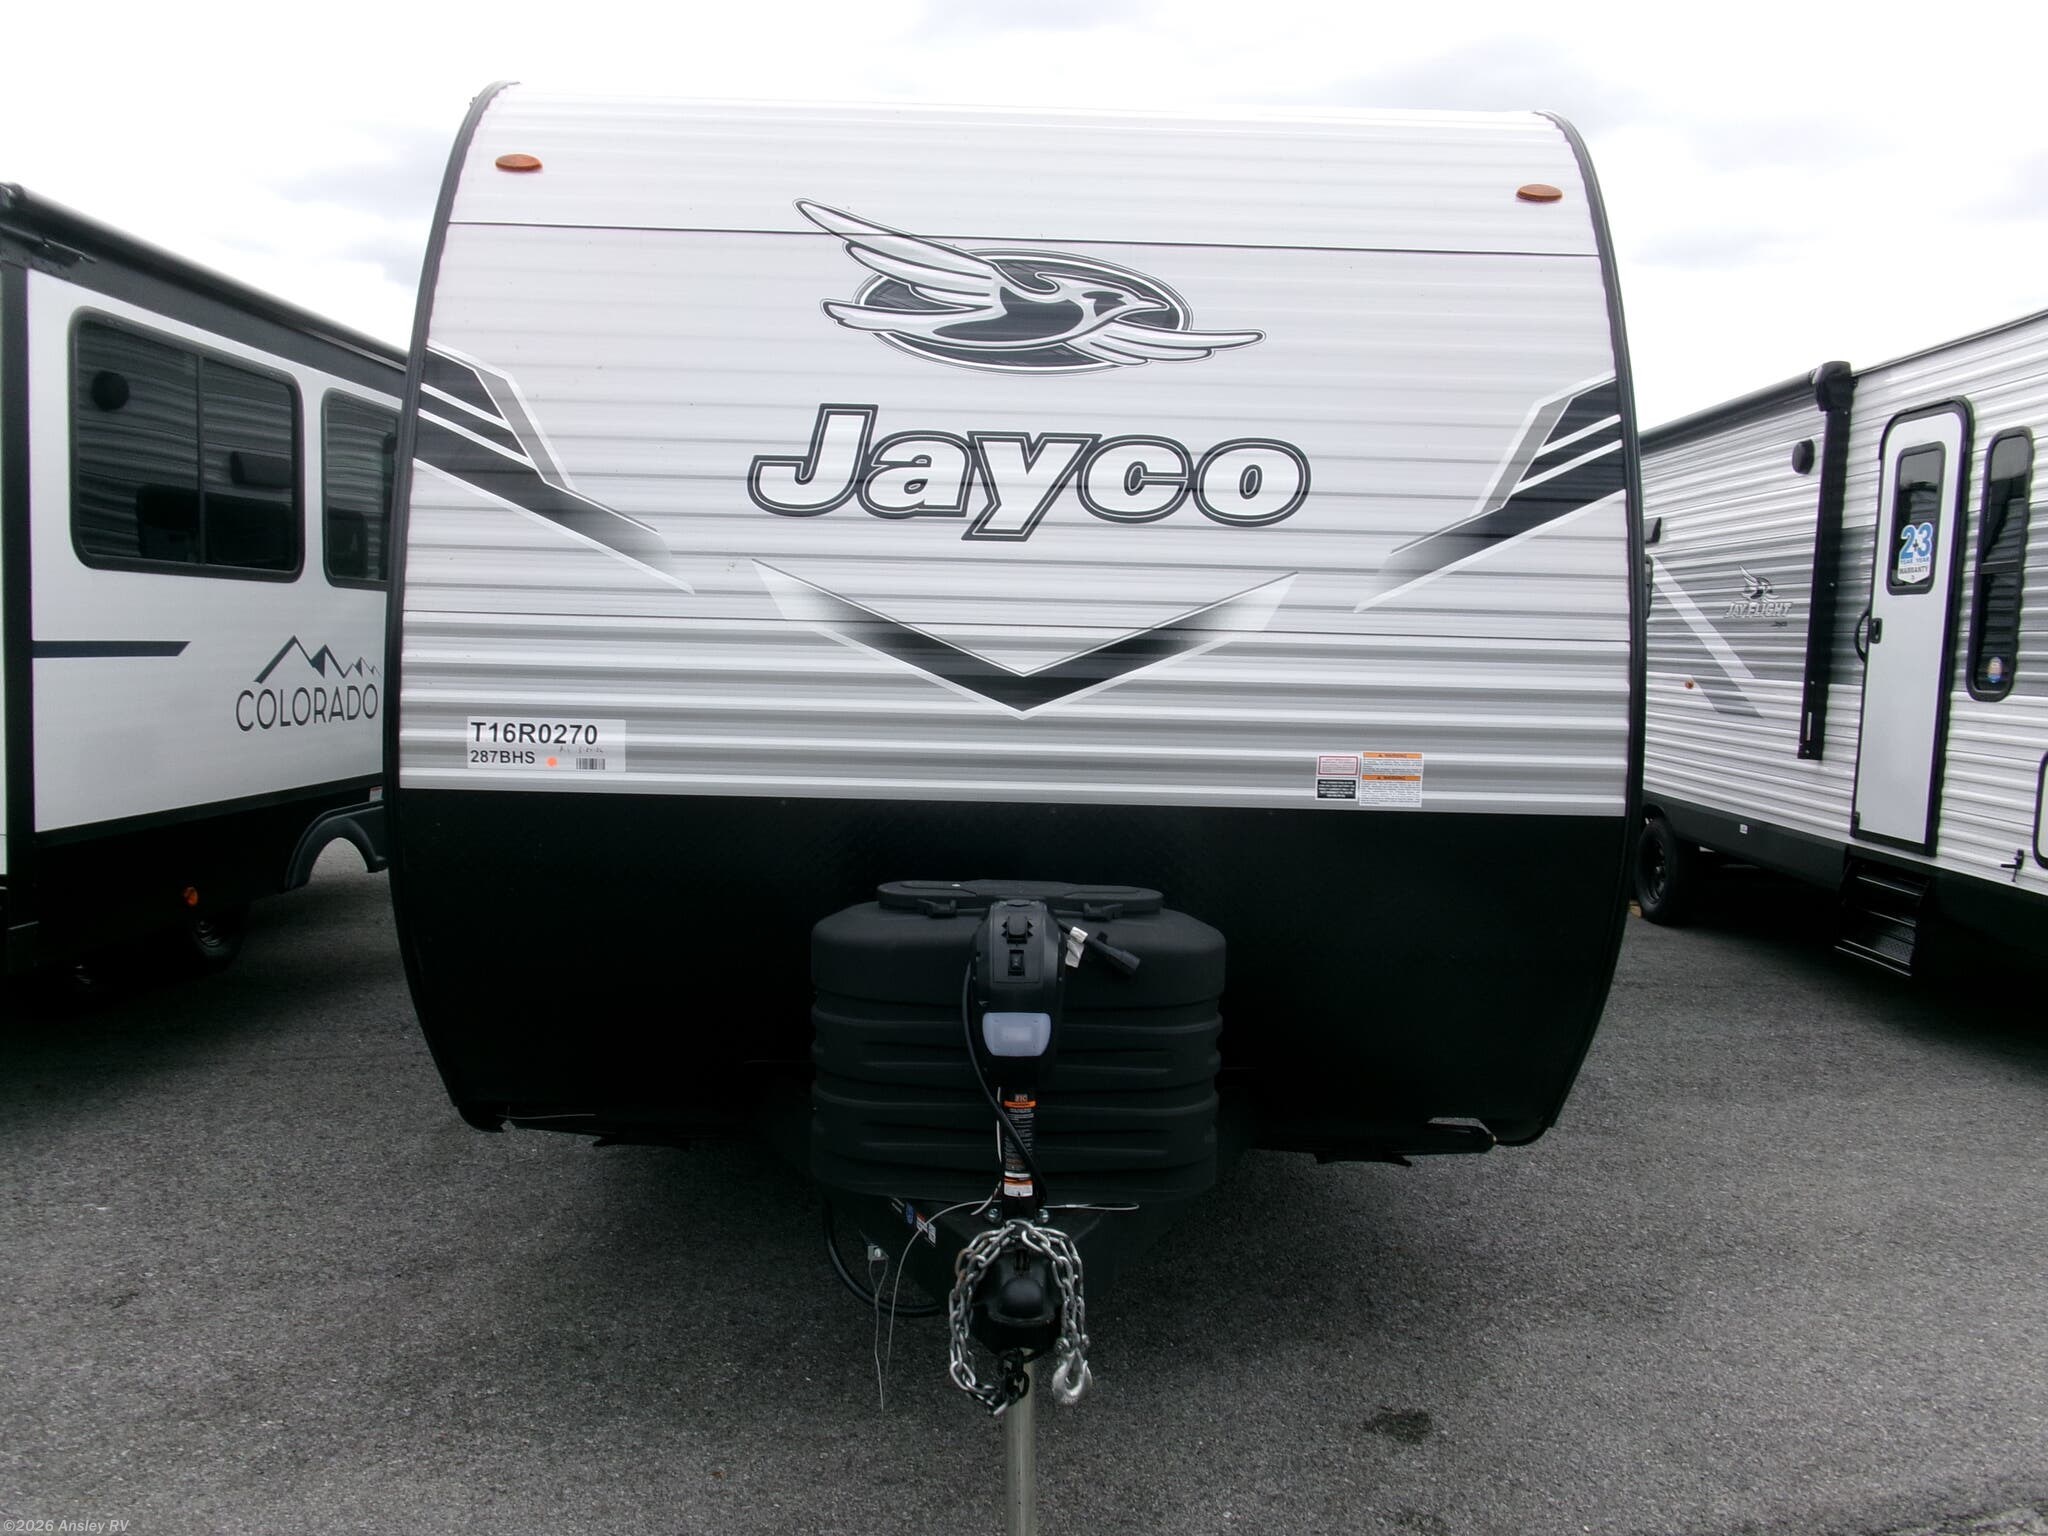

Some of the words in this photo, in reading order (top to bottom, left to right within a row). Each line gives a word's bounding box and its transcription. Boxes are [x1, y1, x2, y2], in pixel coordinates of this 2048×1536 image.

[746, 402, 1312, 542] Jayco
[1725, 602, 1748, 618] JAY
[1747, 602, 1793, 618] FLIGHT
[236, 683, 379, 732] COLORADO
[470, 722, 598, 745] T16R0270
[470, 750, 536, 764] 287BHS
